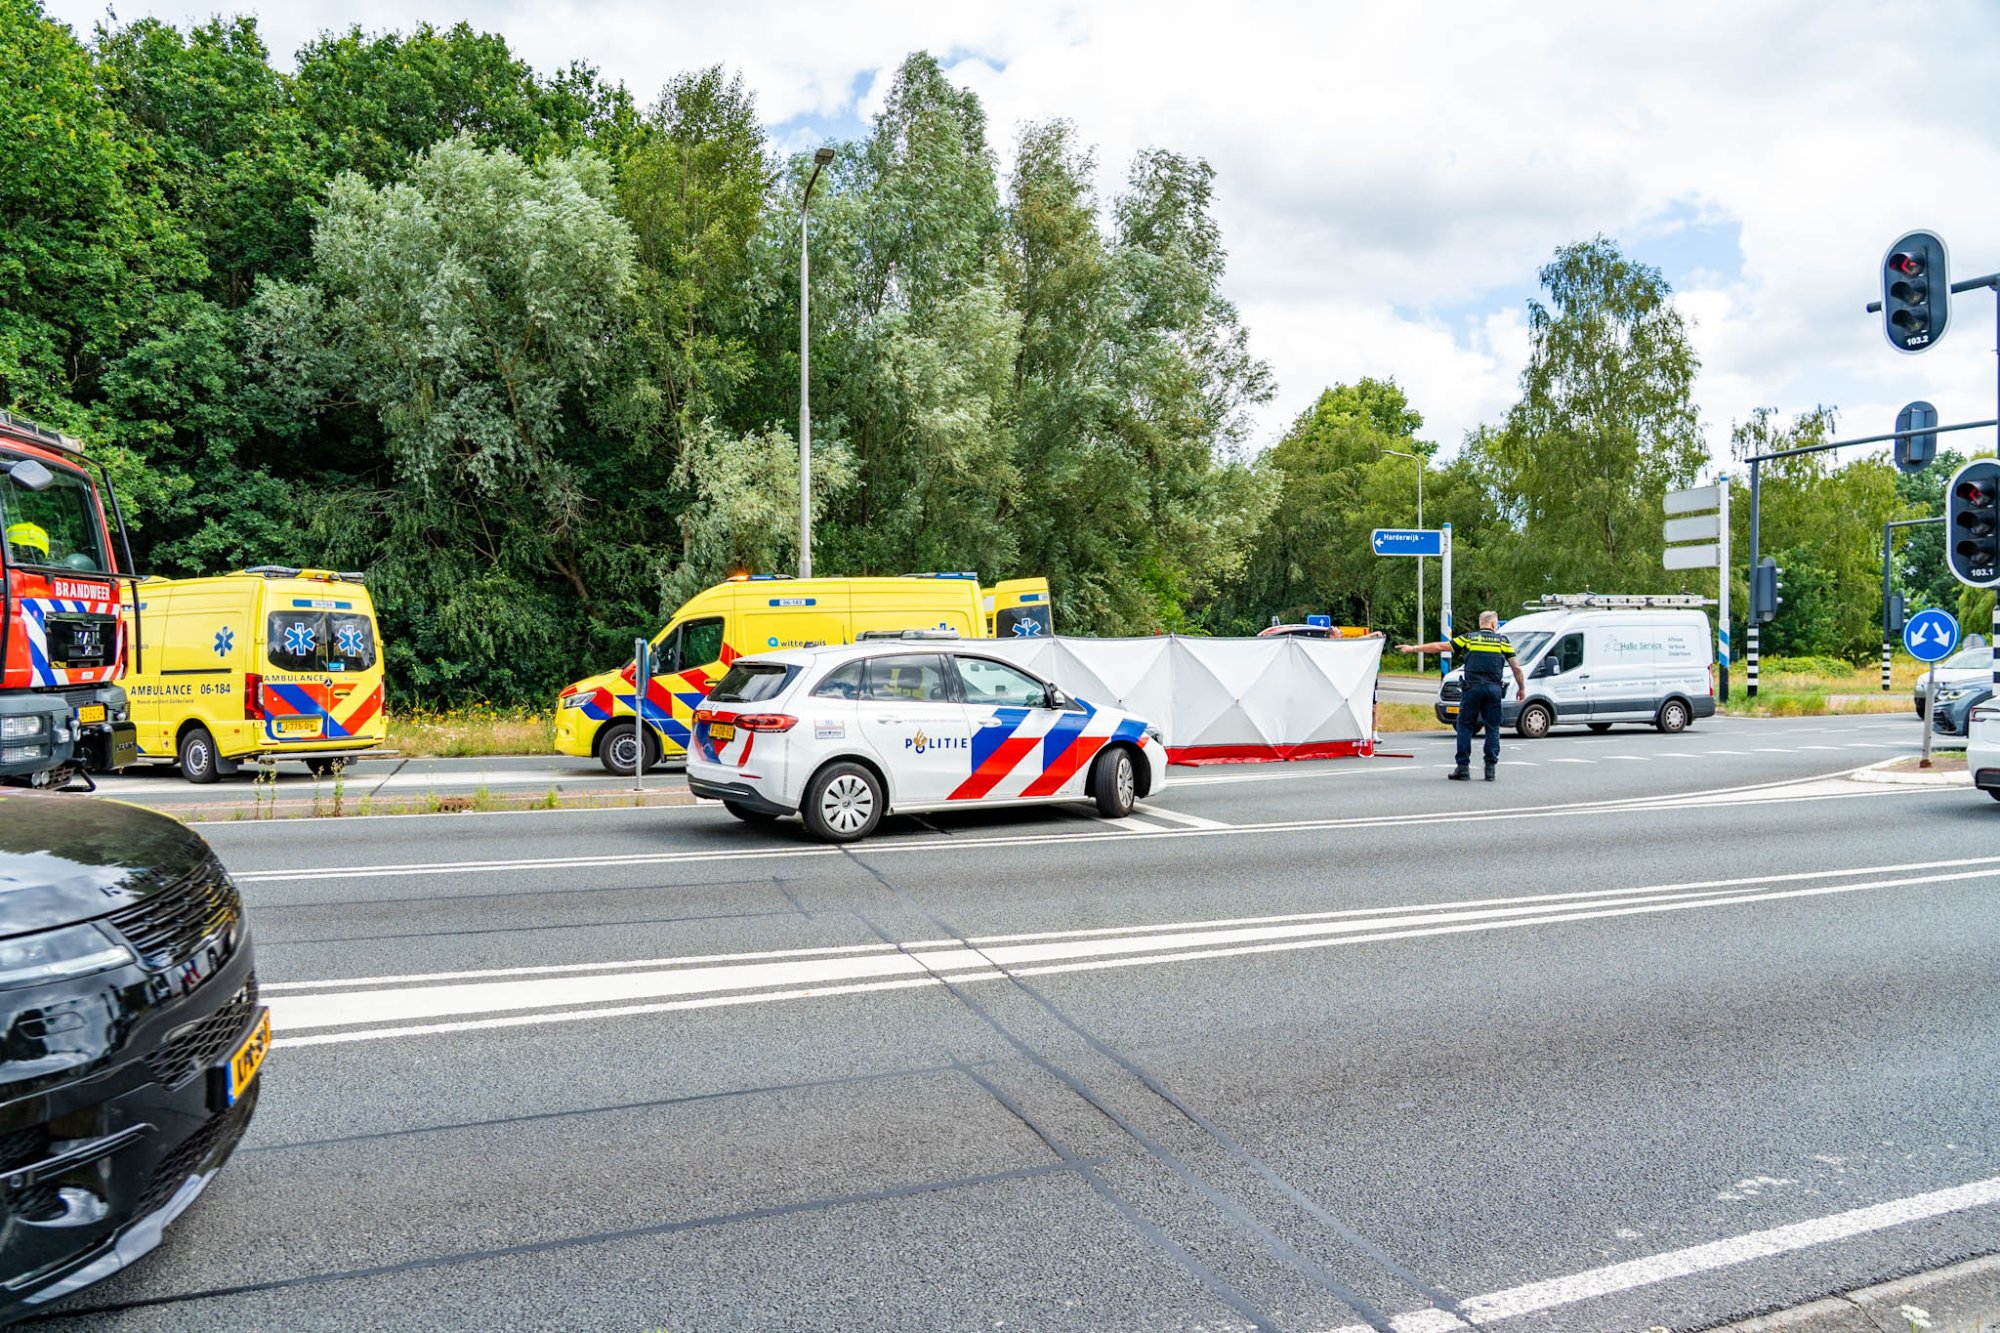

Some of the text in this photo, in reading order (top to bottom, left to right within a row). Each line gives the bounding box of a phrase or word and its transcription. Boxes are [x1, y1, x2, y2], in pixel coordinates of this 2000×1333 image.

[1906, 335, 1929, 346] 103.2
[1384, 533, 1419, 542] Harderwijk
[1971, 568, 1994, 577] 103.1
[55, 581, 110, 600] BRANDWEER
[264, 674, 324, 682] AMBULANCE
[130, 684, 192, 696] AMBULANCE
[905, 738, 968, 754] POLITIE
